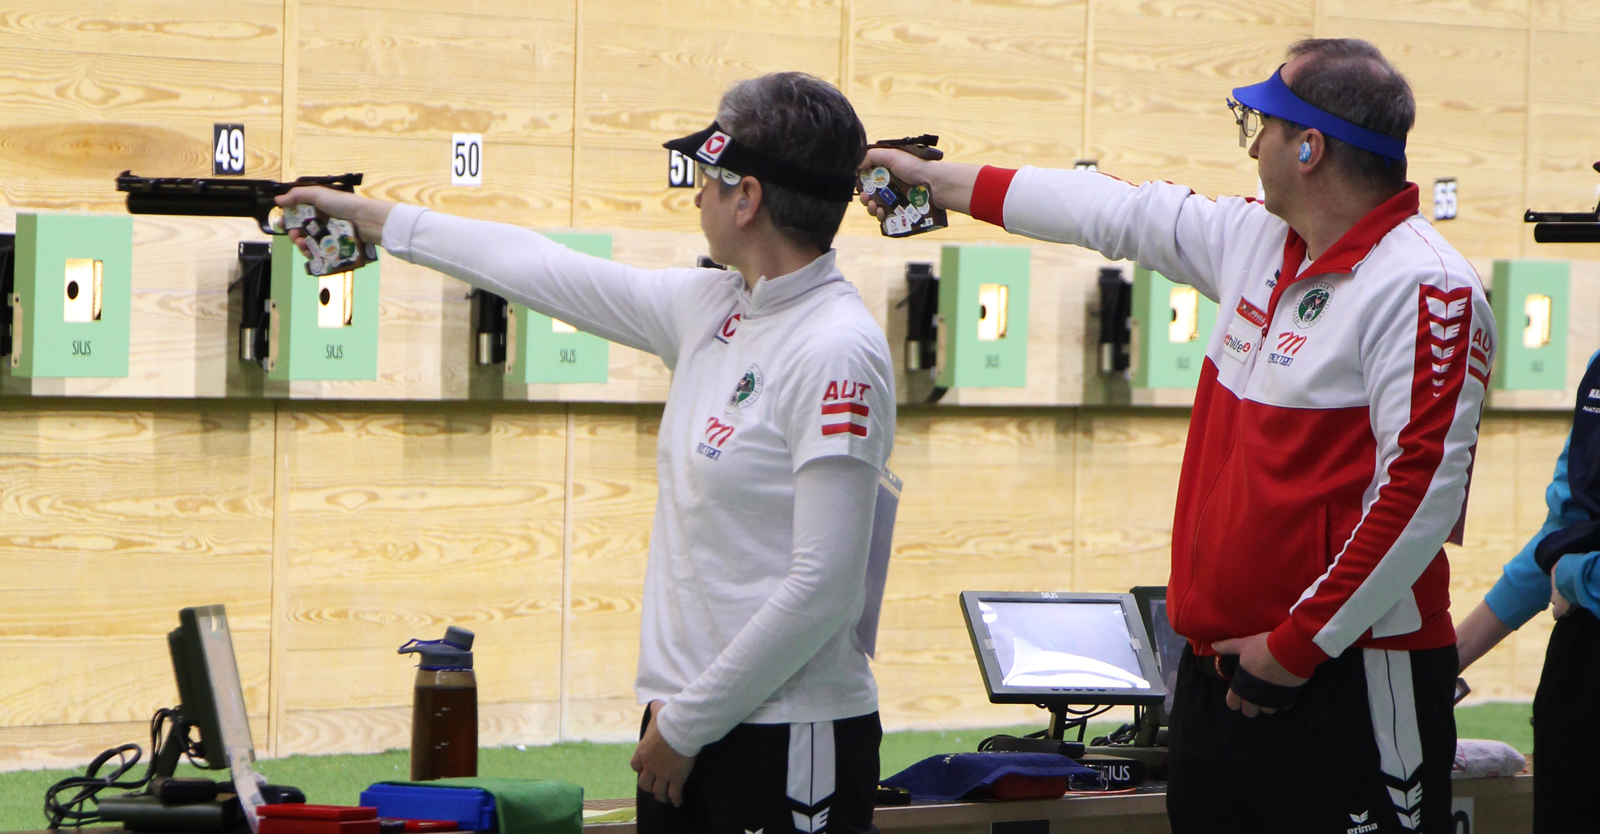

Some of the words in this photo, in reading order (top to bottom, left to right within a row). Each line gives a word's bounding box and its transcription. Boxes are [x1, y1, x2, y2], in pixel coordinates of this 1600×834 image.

[215, 128, 245, 172] 49
[454, 141, 480, 178] 50
[670, 149, 694, 186] 51
[72, 339, 92, 356] SIUS
[325, 344, 344, 359] SIUS
[559, 348, 576, 363] SIUS
[822, 379, 872, 402] AUT
[1040, 591, 1059, 599] SIUS
